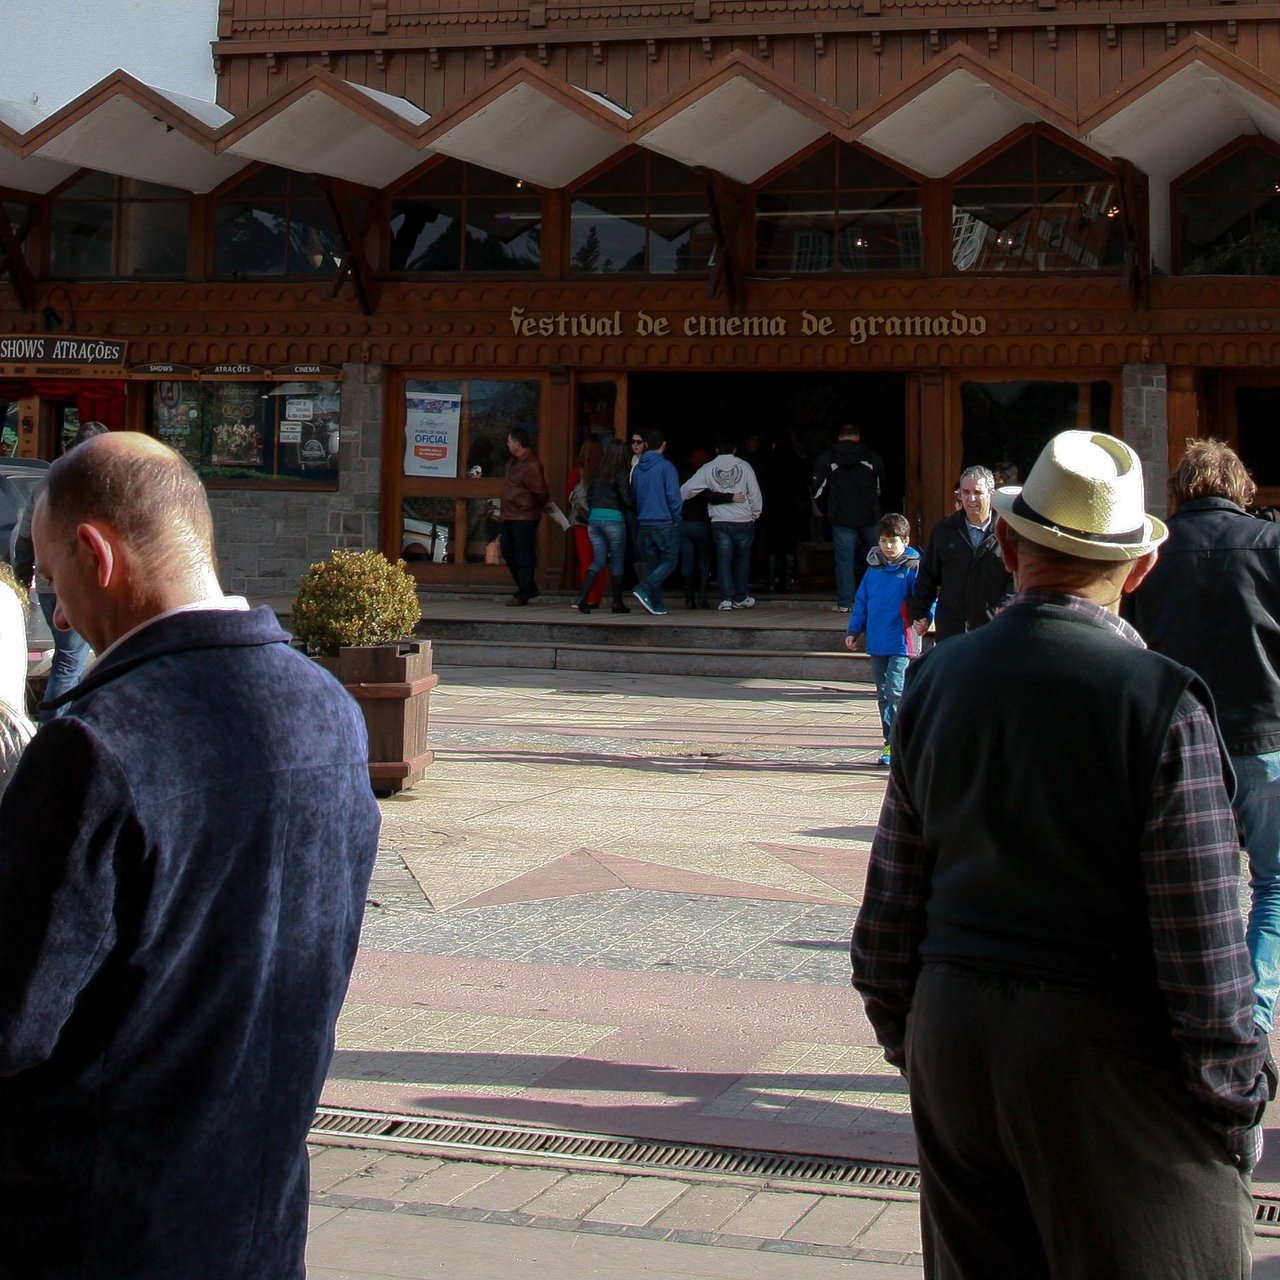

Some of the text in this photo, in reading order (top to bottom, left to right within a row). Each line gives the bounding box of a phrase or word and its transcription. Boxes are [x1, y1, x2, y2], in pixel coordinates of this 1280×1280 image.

[636, 310, 670, 337] de
[683, 311, 787, 337] cinema
[801, 310, 836, 337] de
[850, 310, 987, 344] gramado
[0, 339, 45, 358] SHOWS
[52, 341, 120, 363] ATRAÇÕES
[214, 364, 251, 374] ATRAÇÕES
[414, 434, 448, 444] OFICIAL
